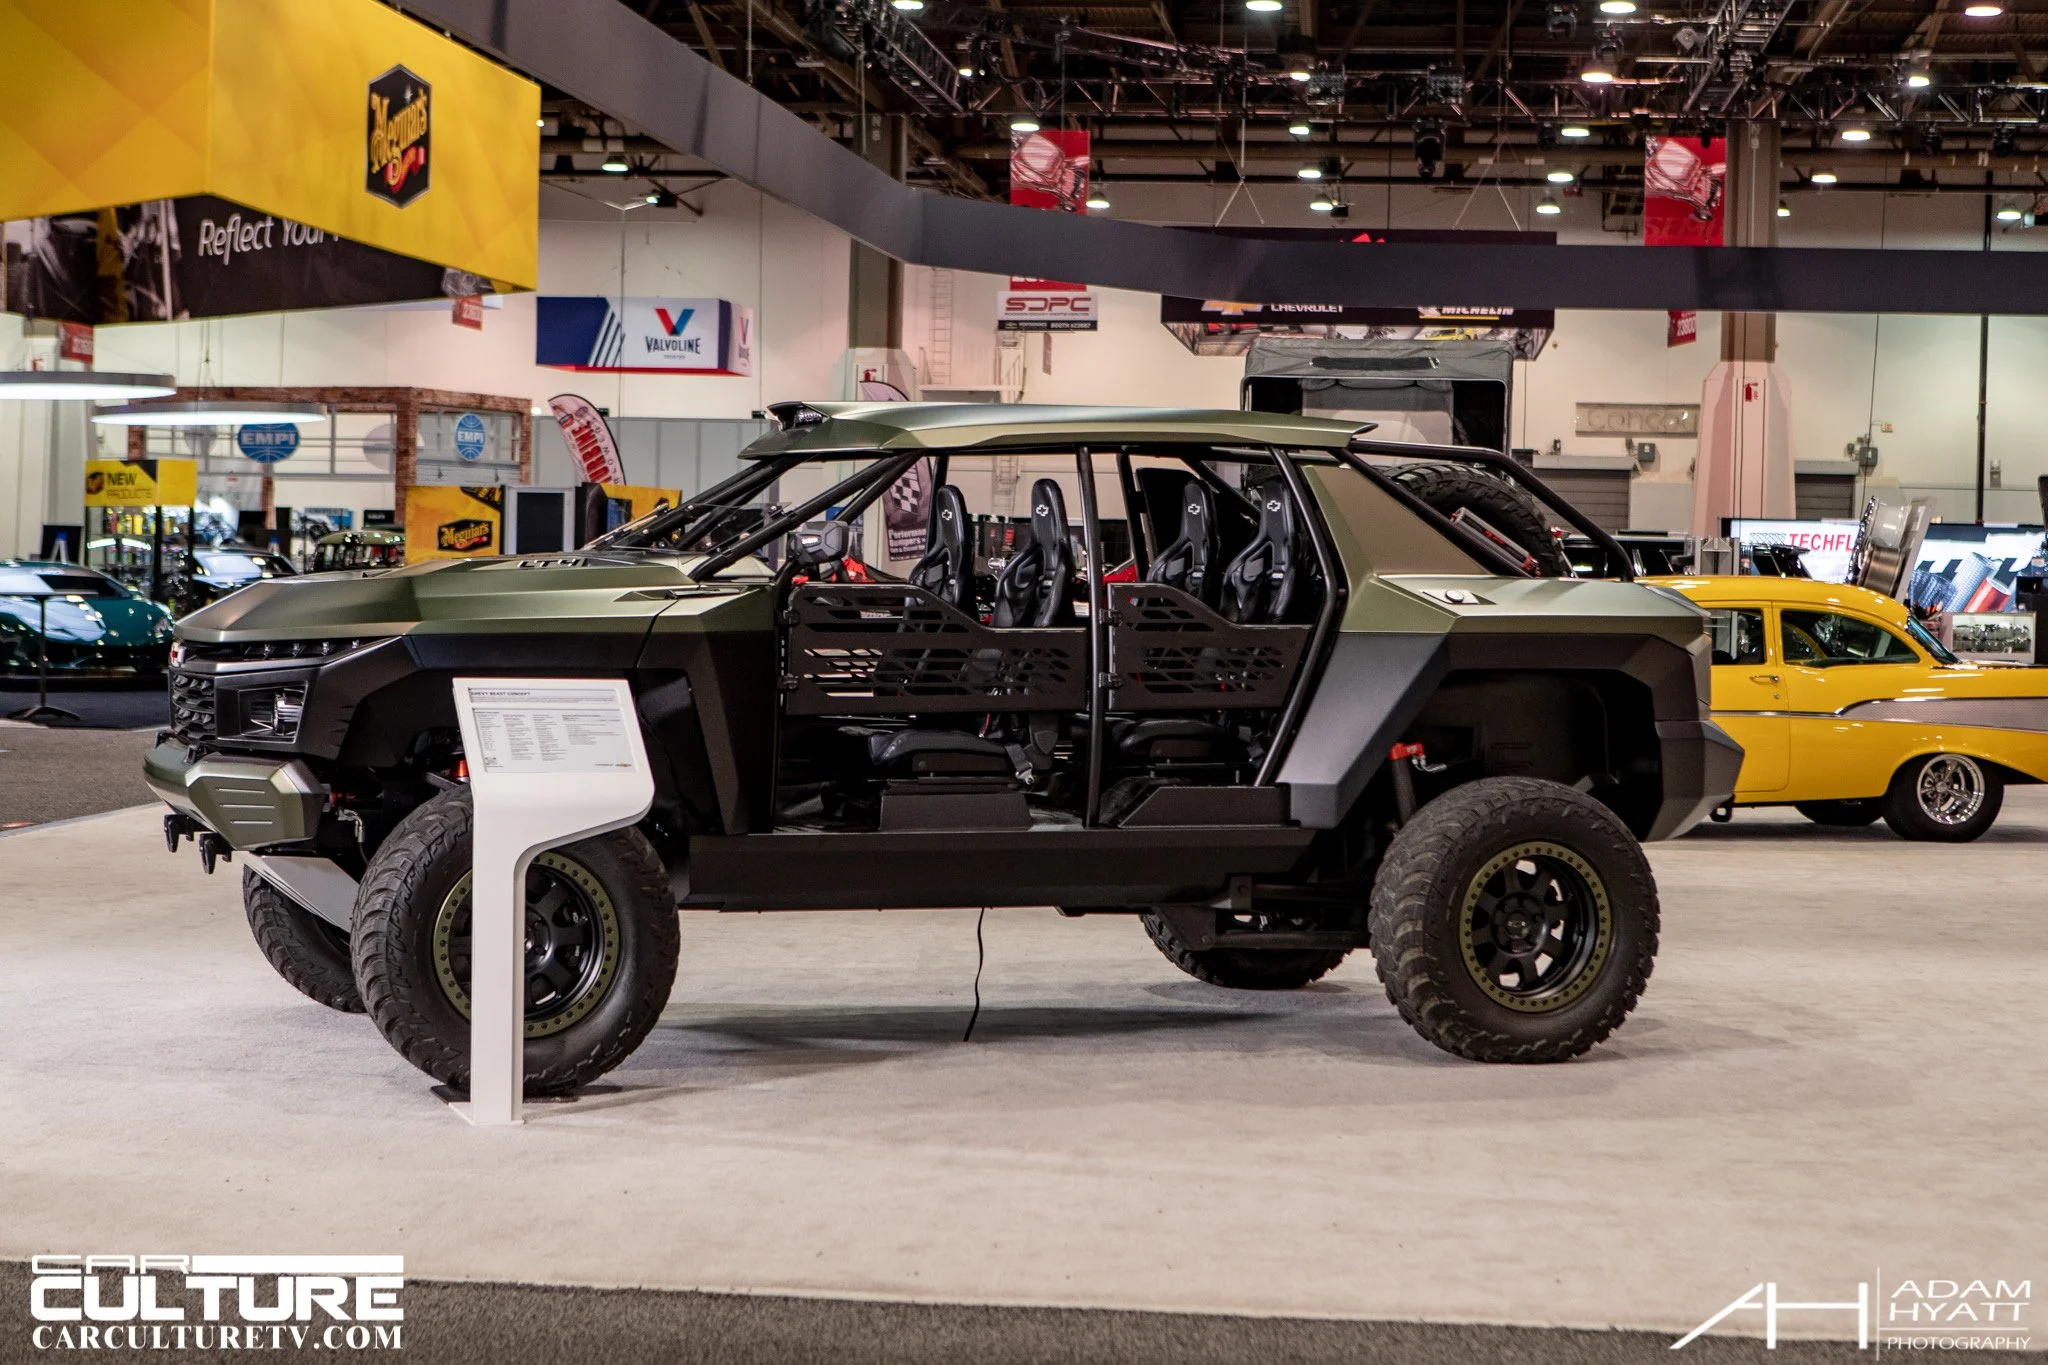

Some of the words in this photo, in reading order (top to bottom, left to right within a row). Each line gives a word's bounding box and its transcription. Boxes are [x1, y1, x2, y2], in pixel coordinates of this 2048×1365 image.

[371, 88, 428, 185] Meguiar's
[198, 212, 275, 265] Reflect
[1005, 297, 1091, 312] SDPC
[645, 335, 701, 355] VALVOLINE
[241, 432, 296, 445] EMPI
[457, 430, 484, 444] EMPI
[107, 473, 138, 486] NEW
[107, 488, 152, 500] PRODUCTS
[440, 522, 490, 547] Meguiar's
[1789, 533, 1855, 552] TECHFL
